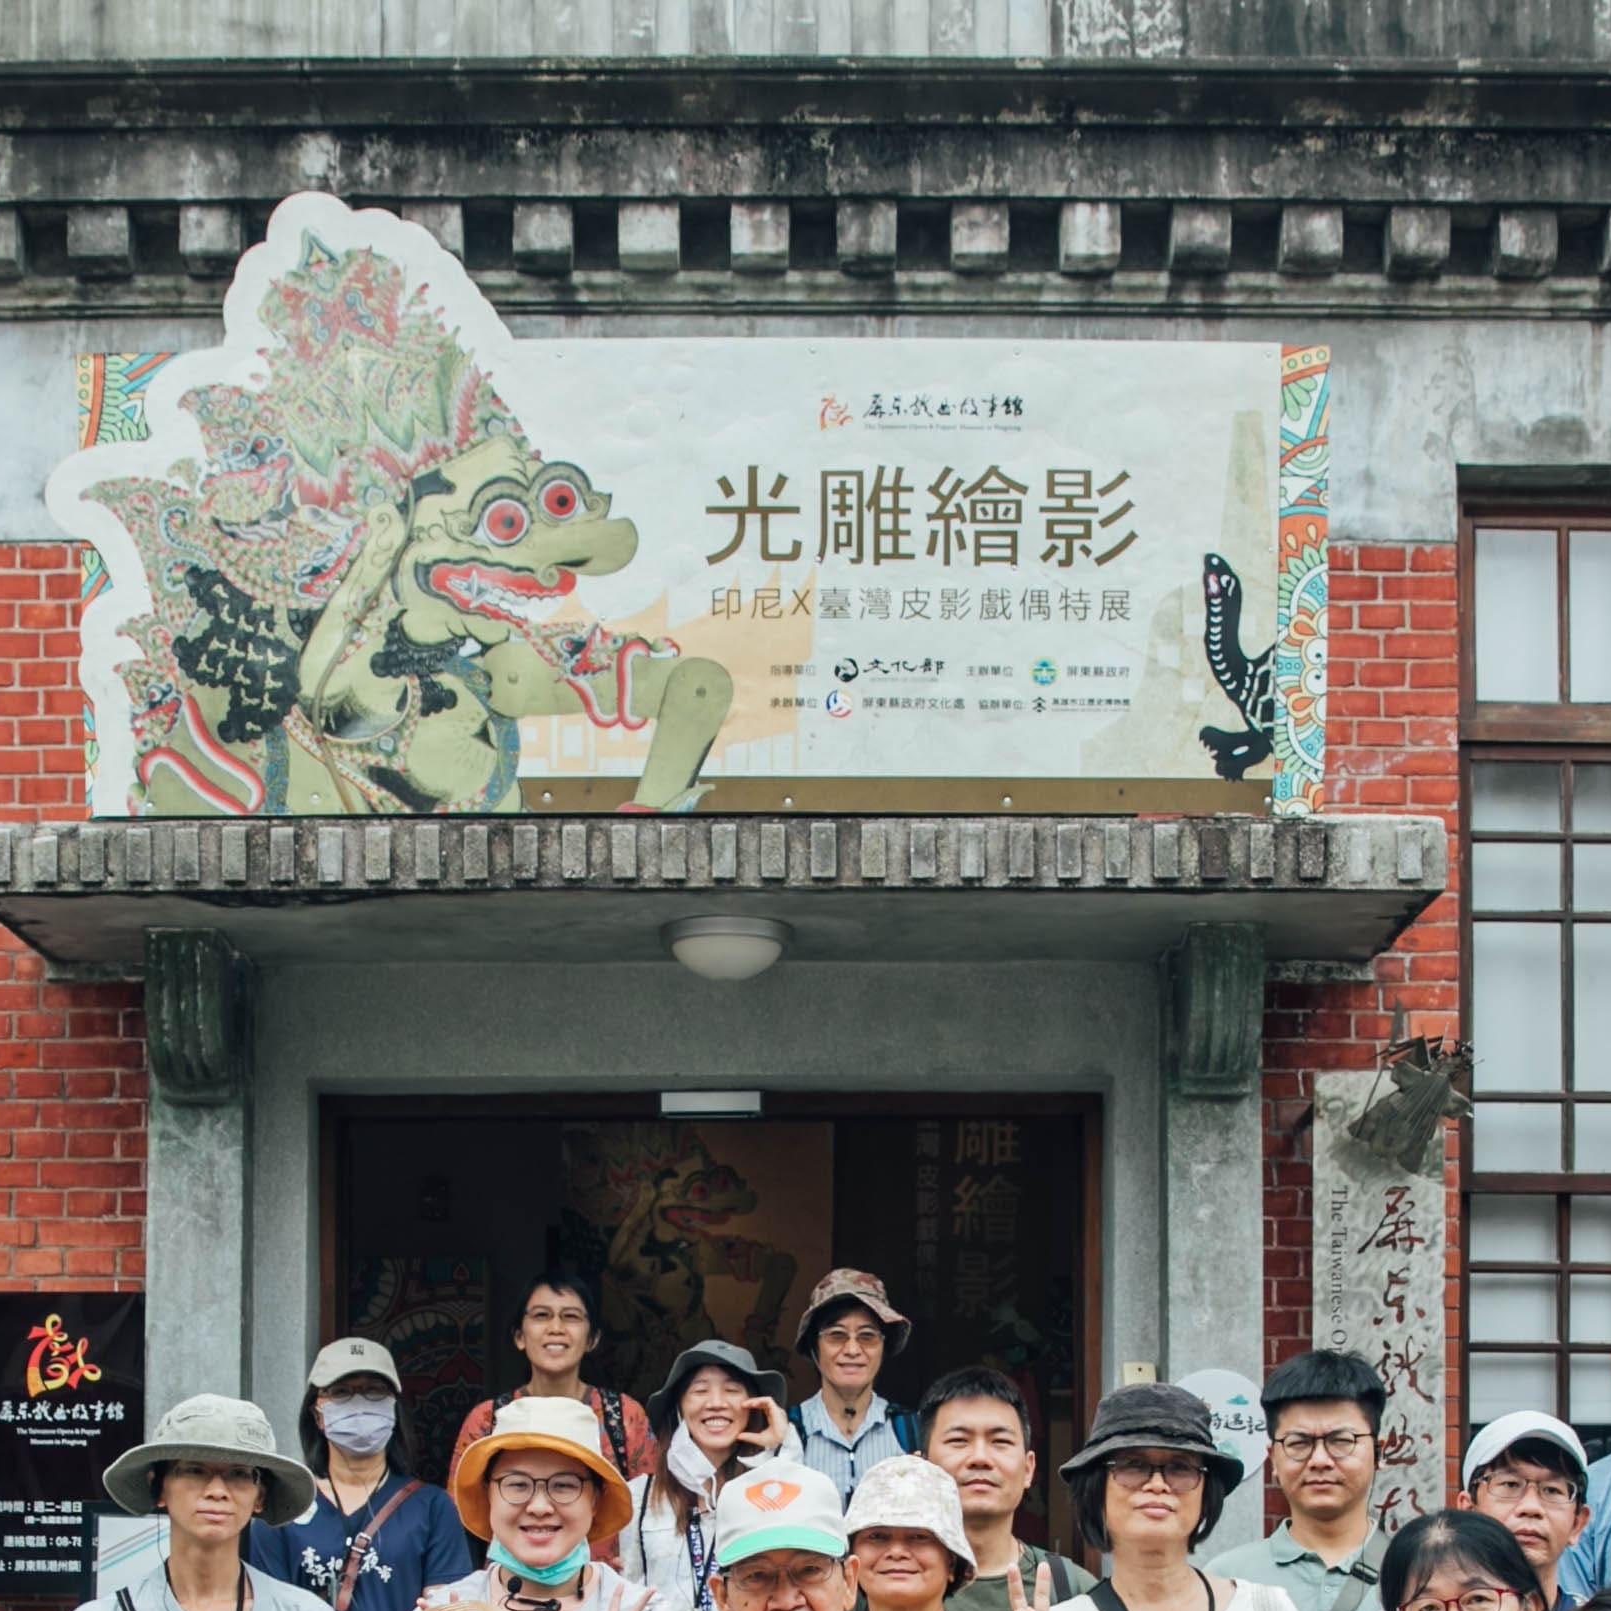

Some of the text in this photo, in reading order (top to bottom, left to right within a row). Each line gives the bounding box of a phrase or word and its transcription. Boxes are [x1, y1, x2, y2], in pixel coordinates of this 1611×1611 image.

[705, 465, 1139, 568] 光雕繪影
[710, 587, 1132, 622] 印尼X臺灣皮影戲偶特展
[863, 657, 945, 675] 文化部
[1331, 1185, 1348, 1222] The
[1330, 1227, 1348, 1325] Taiwanese
